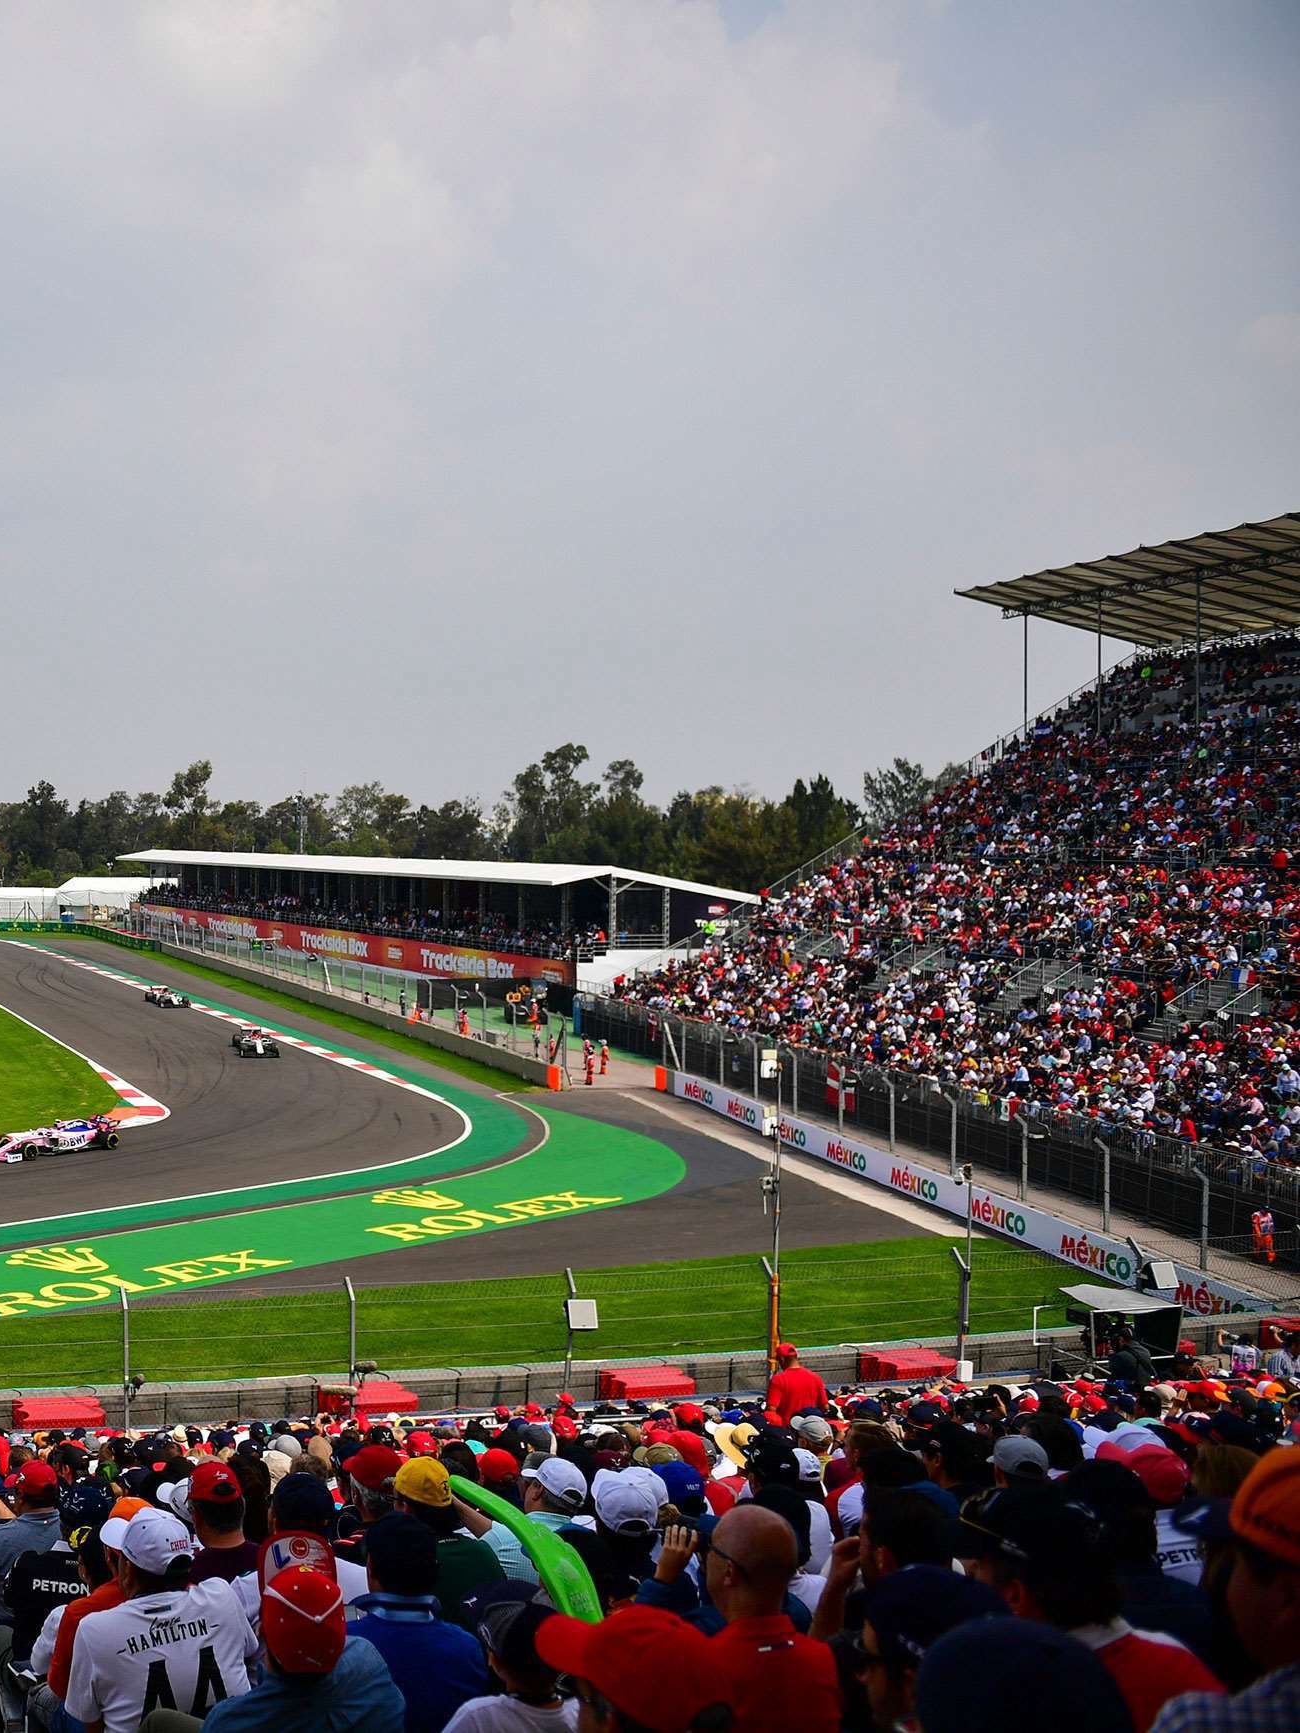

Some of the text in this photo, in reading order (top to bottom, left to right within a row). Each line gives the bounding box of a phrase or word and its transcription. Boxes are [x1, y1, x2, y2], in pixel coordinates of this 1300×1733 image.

[300, 931, 346, 954] Trackside
[347, 937, 368, 957] Box
[420, 949, 487, 977] Trackside
[487, 958, 515, 979] Box
[70, 1135, 86, 1147] BWT
[364, 1189, 624, 1242] ROLEX
[32, 1578, 91, 1597] PETRON
[126, 1618, 208, 1655] HAMILTON
